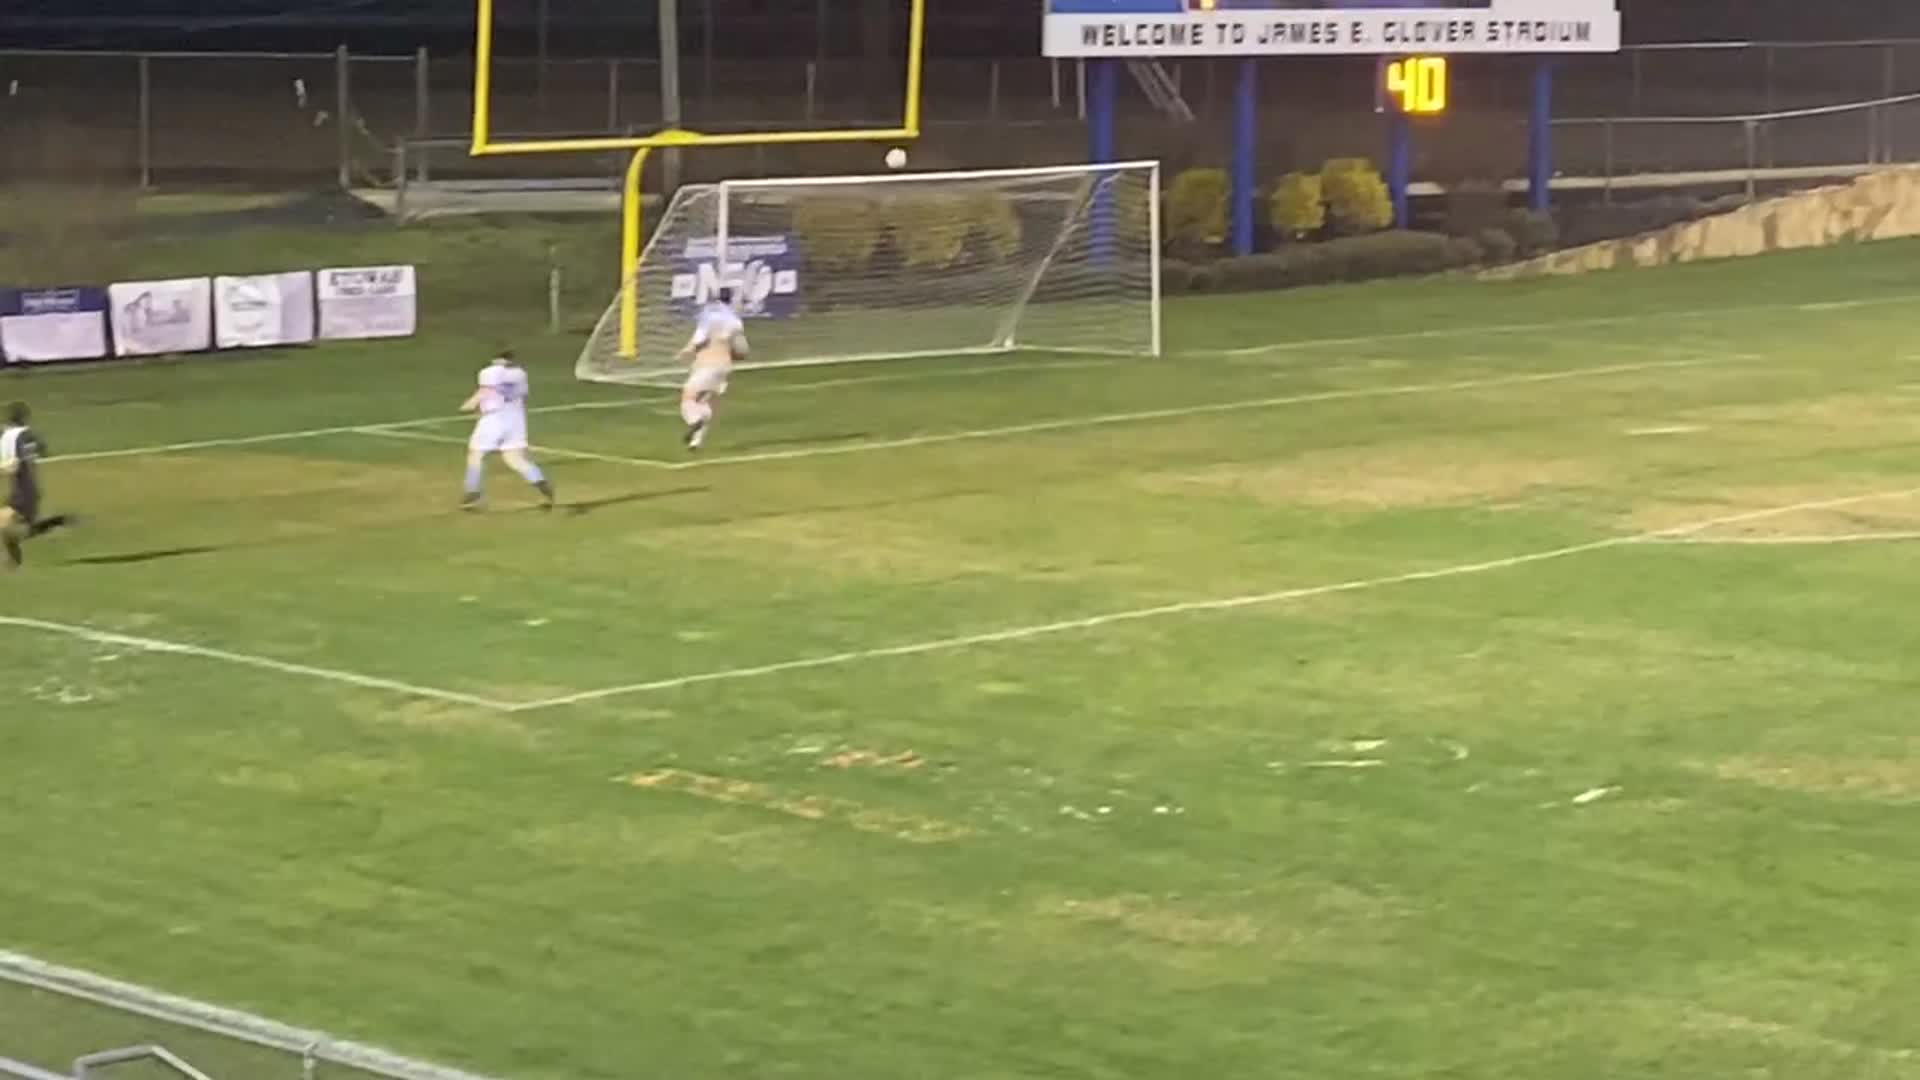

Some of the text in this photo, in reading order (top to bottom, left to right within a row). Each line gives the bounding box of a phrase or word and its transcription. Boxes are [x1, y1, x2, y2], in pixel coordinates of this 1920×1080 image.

[1082, 23, 1204, 46] WELCOME
[1216, 23, 1246, 44] TO
[1257, 22, 1339, 45] JAMES
[1485, 20, 1591, 42] STADIUM
[1387, 56, 1446, 113] 40
